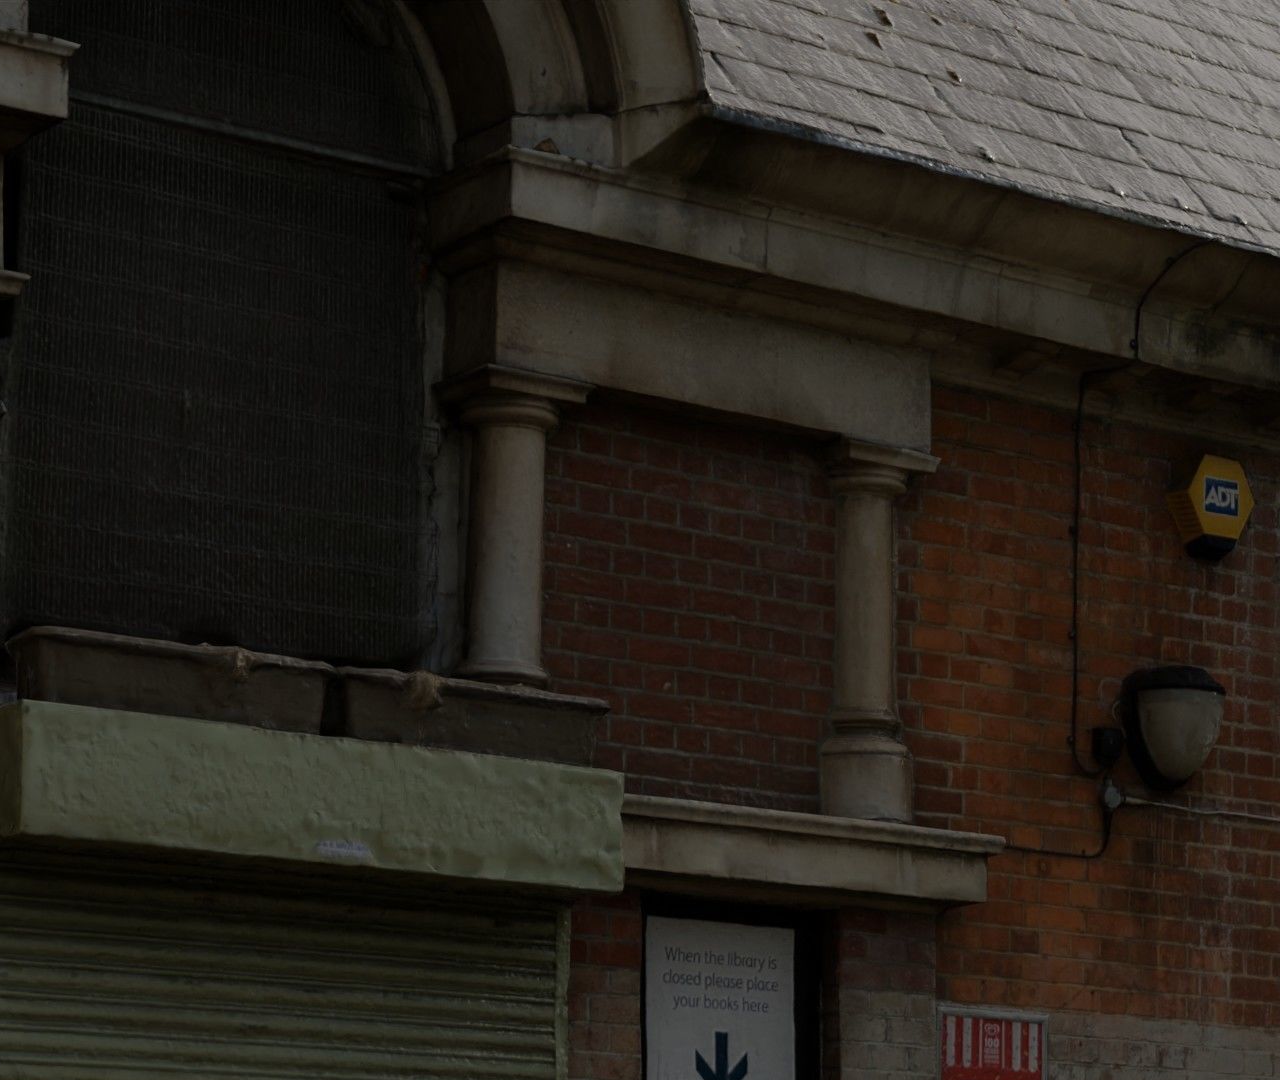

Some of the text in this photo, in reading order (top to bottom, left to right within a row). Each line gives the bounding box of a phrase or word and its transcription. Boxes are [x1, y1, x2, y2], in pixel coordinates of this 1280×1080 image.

[1206, 485, 1239, 509] ADT
[664, 946, 778, 973] When the library is
[662, 968, 779, 992] closed please place
[672, 994, 769, 1013] your books here
